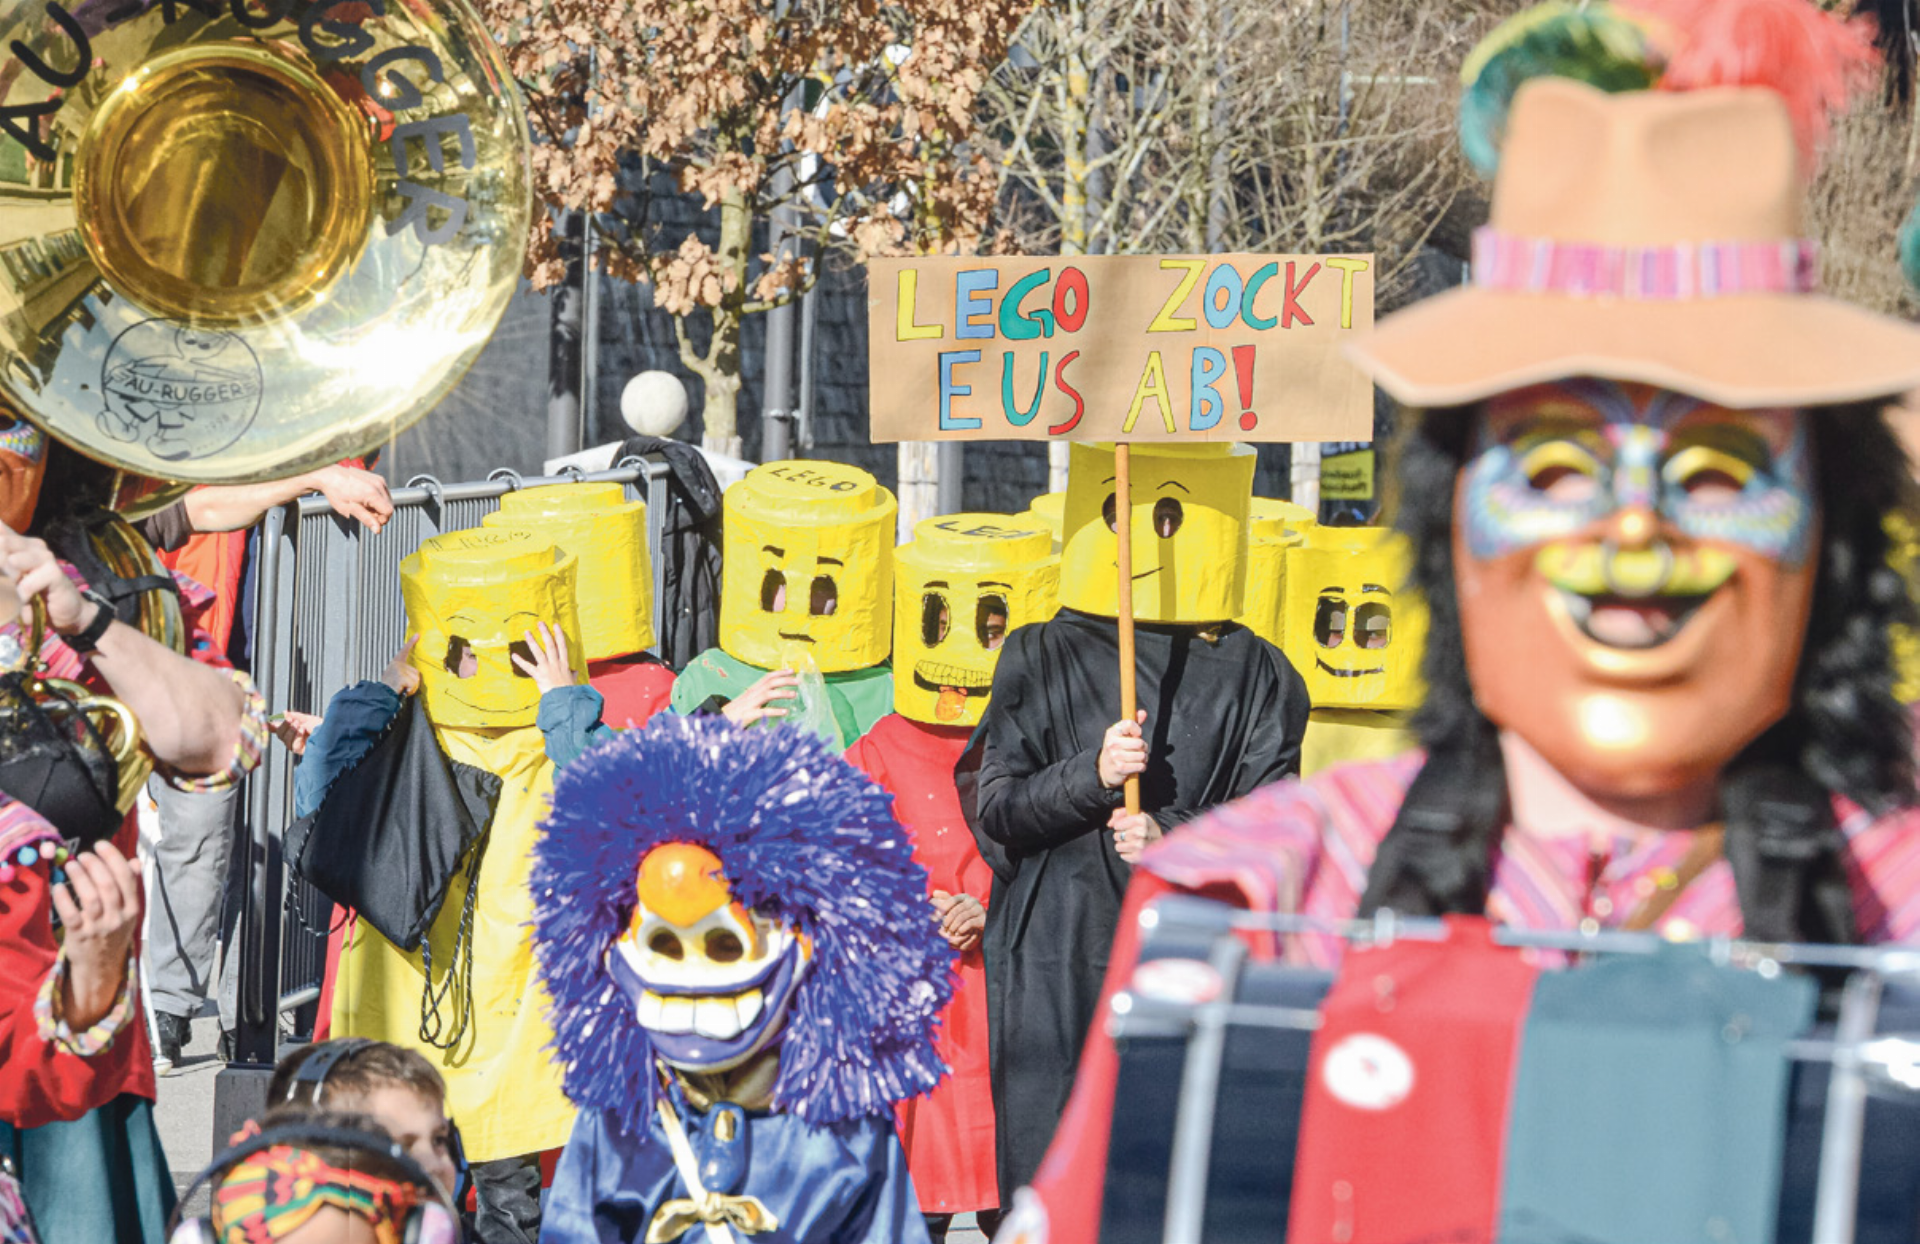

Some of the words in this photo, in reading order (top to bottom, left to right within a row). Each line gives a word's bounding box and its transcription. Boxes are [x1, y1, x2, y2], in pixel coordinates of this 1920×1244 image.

[896, 266, 1090, 341] LEGO
[1146, 257, 1369, 332] ZOCKT
[125, 376, 243, 401] AU-RUGGER
[938, 349, 1085, 435] EUS
[1122, 344, 1258, 434] AB!
[767, 467, 859, 492] LEGO
